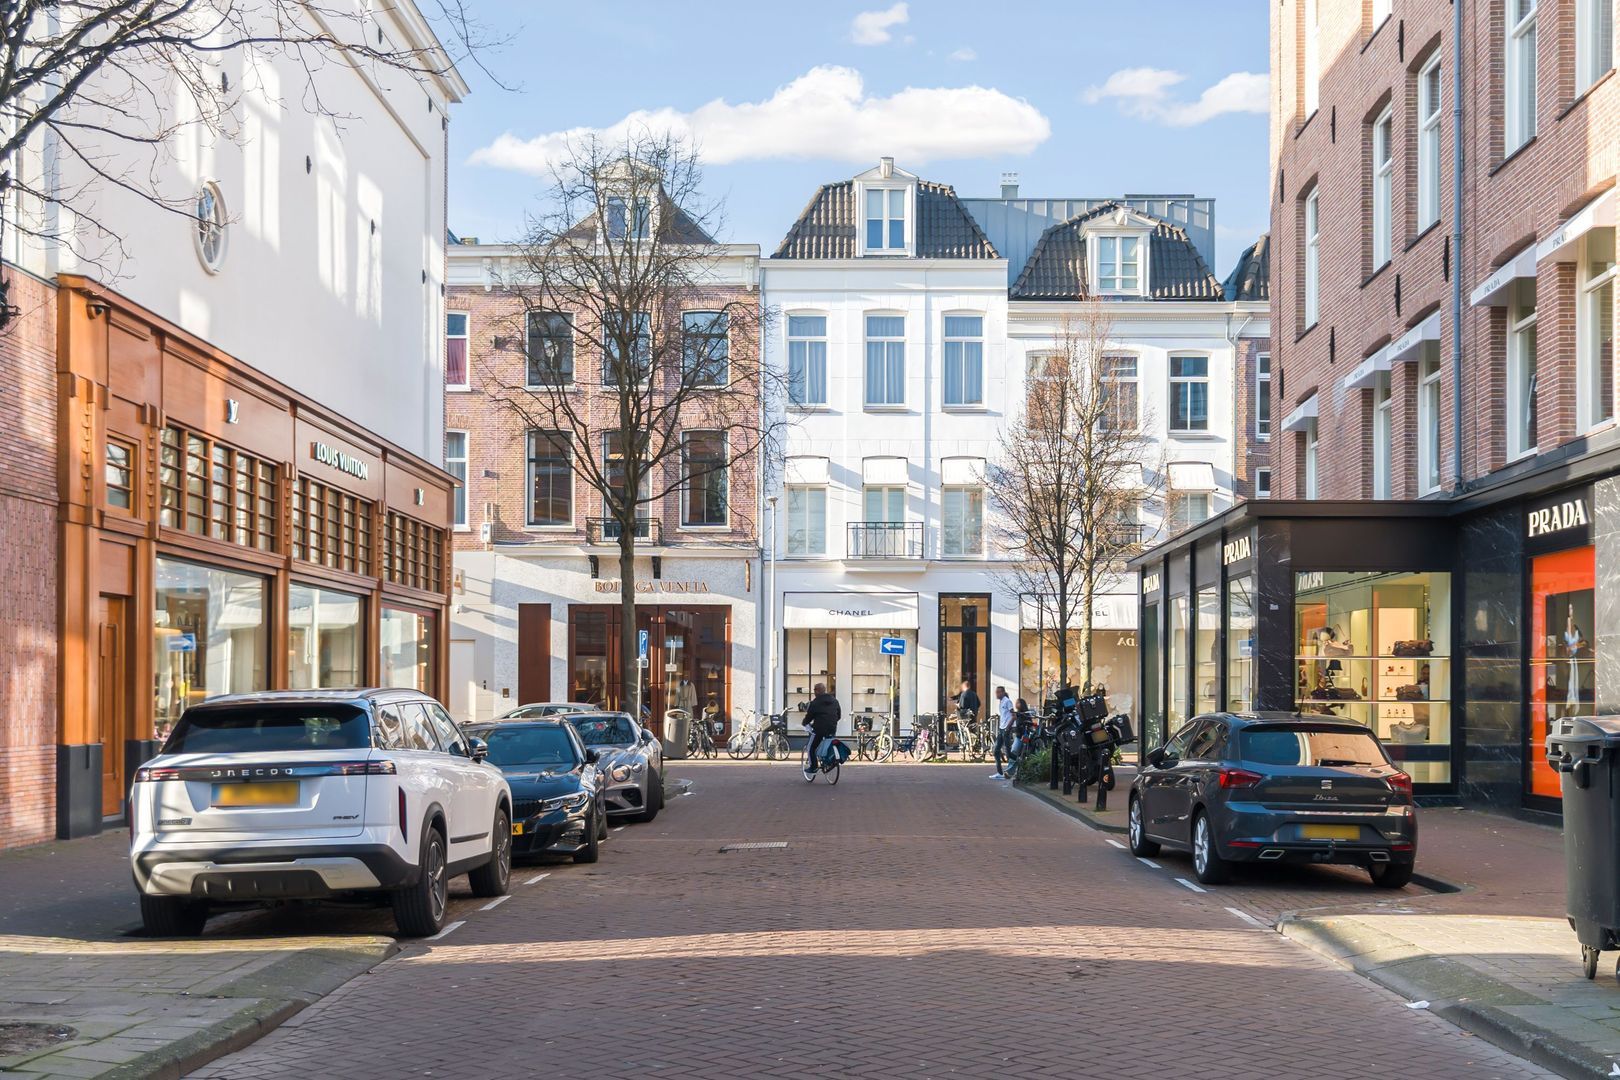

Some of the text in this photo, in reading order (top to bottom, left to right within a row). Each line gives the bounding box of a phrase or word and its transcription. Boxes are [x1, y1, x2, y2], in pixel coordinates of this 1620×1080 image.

[316, 441, 369, 481] LOUIS VUITTON
[1527, 499, 1588, 538] PRADA
[1223, 536, 1251, 566] PRADA
[595, 581, 710, 593] BOTGA VENETA
[1143, 573, 1160, 594] PRADA
[828, 609, 874, 617] CHANEL
